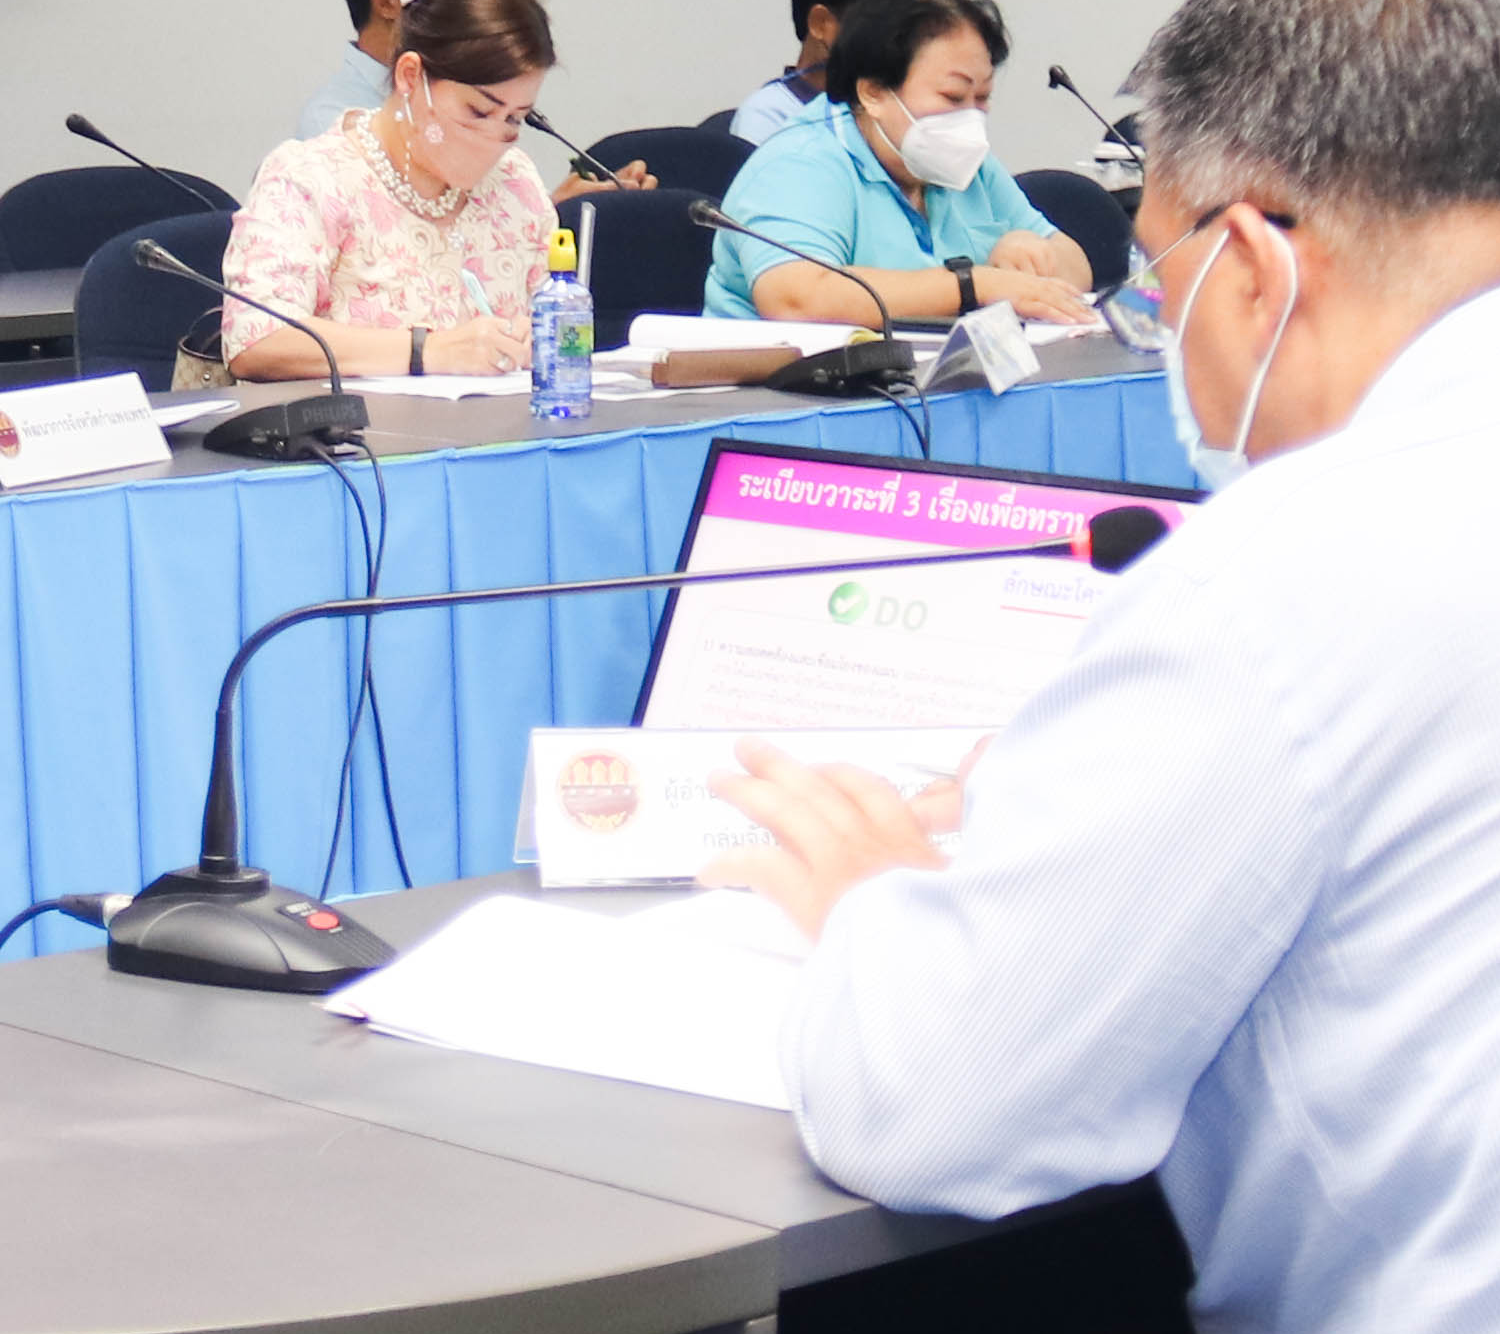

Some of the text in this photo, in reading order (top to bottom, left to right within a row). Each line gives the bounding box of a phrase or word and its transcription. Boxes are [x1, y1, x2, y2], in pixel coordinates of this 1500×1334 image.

[737, 470, 900, 514] ระเบียบวาระที่
[904, 491, 921, 516] 3
[1003, 569, 1104, 605] ลักษณะโค
[873, 595, 929, 632] DO
